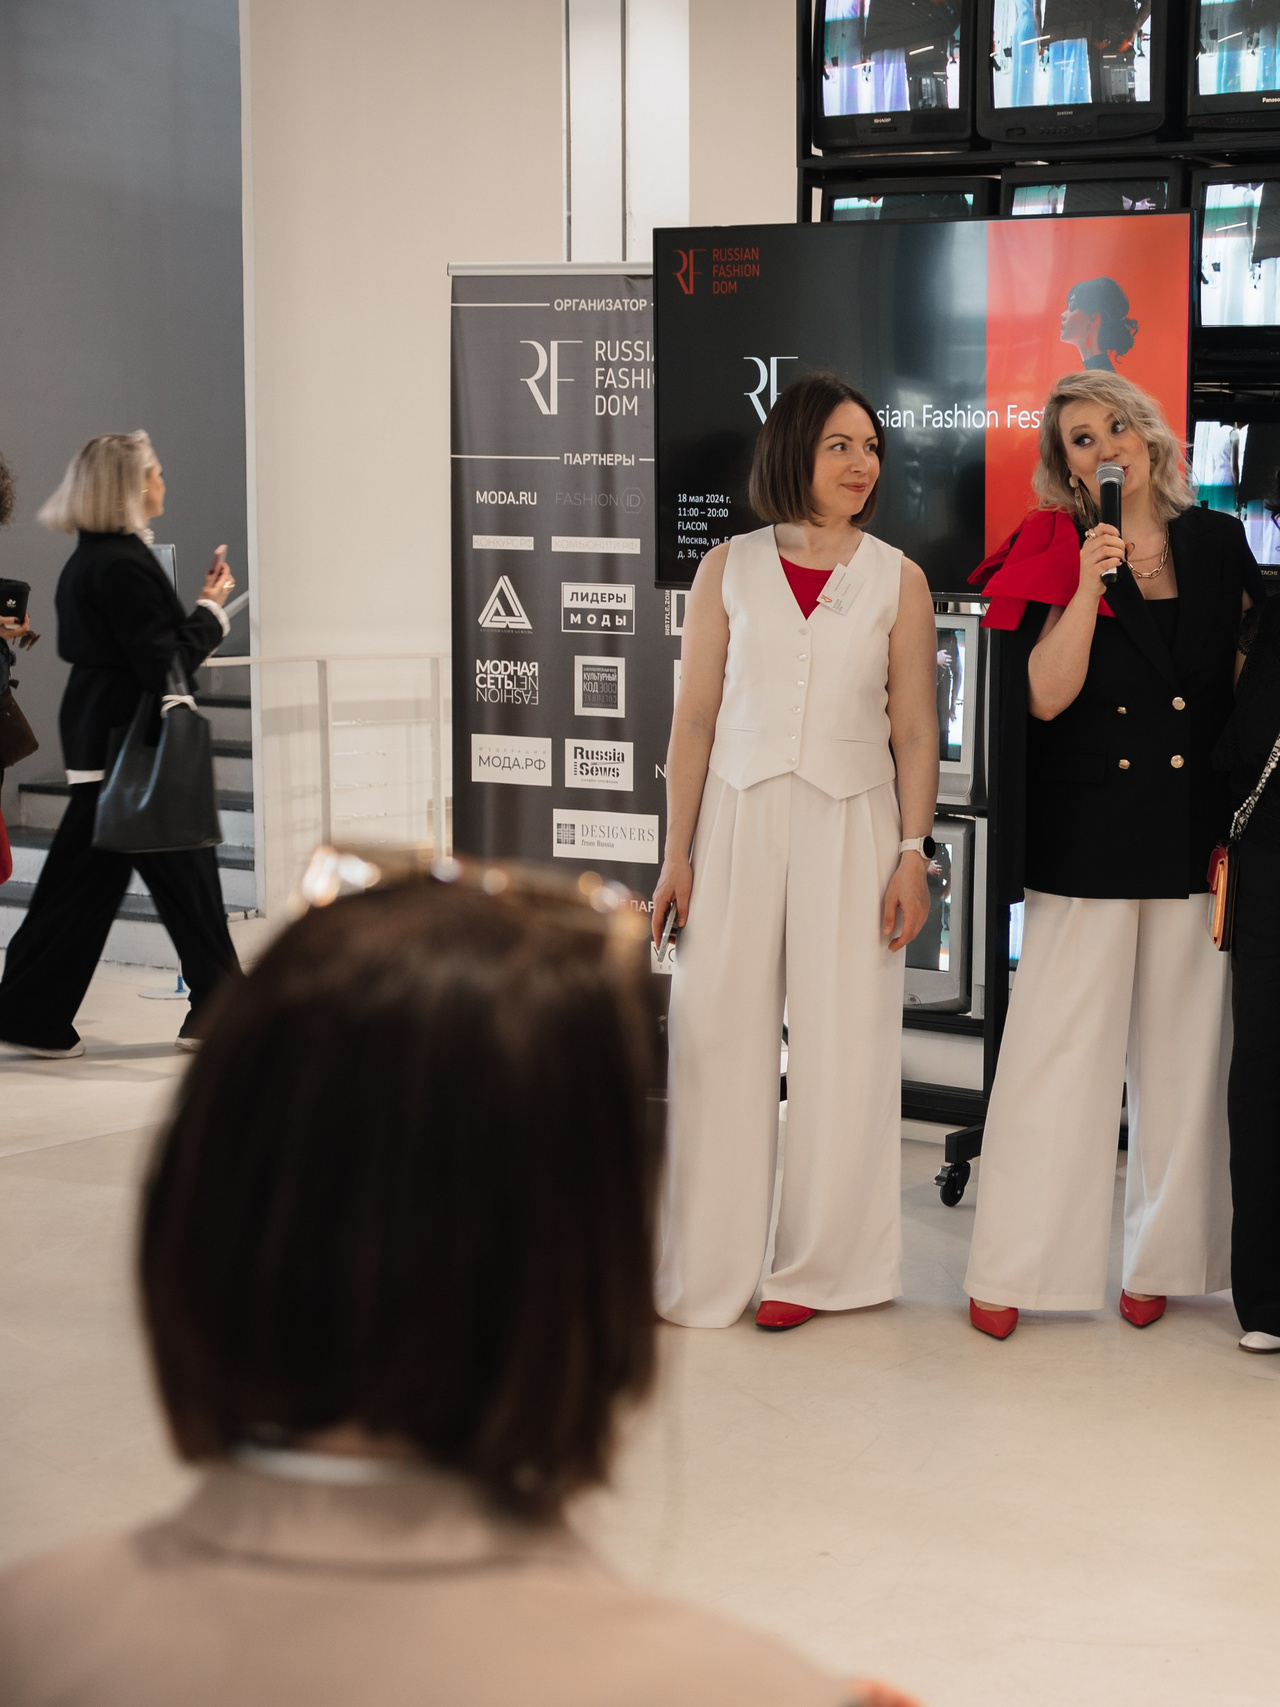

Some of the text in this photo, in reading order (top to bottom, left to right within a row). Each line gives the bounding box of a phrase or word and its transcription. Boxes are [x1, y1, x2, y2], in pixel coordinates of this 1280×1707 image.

[712, 247, 760, 261] RUSSIAN
[712, 264, 760, 278] FASHION
[712, 280, 738, 294] DOM
[553, 298, 648, 312] ОРГАНИЗАТОР
[595, 340, 654, 362] RUSSI
[595, 367, 654, 390] FASHI
[595, 396, 638, 416] DOM
[876, 405, 915, 428] sian
[922, 404, 999, 429] Fashion
[563, 453, 635, 466] ПАРТНЕРЫ
[476, 490, 537, 505] MODA.RU
[555, 492, 641, 508] FASHION ID
[677, 493, 732, 504] 18 мая 2024 г.
[677, 507, 699, 517] 11:00
[707, 508, 729, 518] 20:00
[677, 521, 708, 531] FLACON
[473, 537, 533, 550] КОНКУРС.РФ
[553, 539, 638, 552] КОМЬЮНИТИ.РФ
[677, 535, 710, 546] Москва,
[677, 550, 686, 560] д.
[687, 549, 699, 560] 36,
[569, 591, 627, 604] ЛИДЕРЫ
[569, 613, 627, 627] МОДЫ
[475, 674, 513, 689] СЕТЬ
[583, 672, 617, 682] КУЛЬТУРНЫЙ
[583, 681, 599, 693] КОД
[476, 687, 539, 705] FASHION
[573, 746, 625, 762] Russia
[478, 755, 546, 771] МОДА.РФ
[579, 762, 620, 778] Sews
[581, 824, 655, 842] DESIGNERS
[581, 839, 615, 848] from Russia
